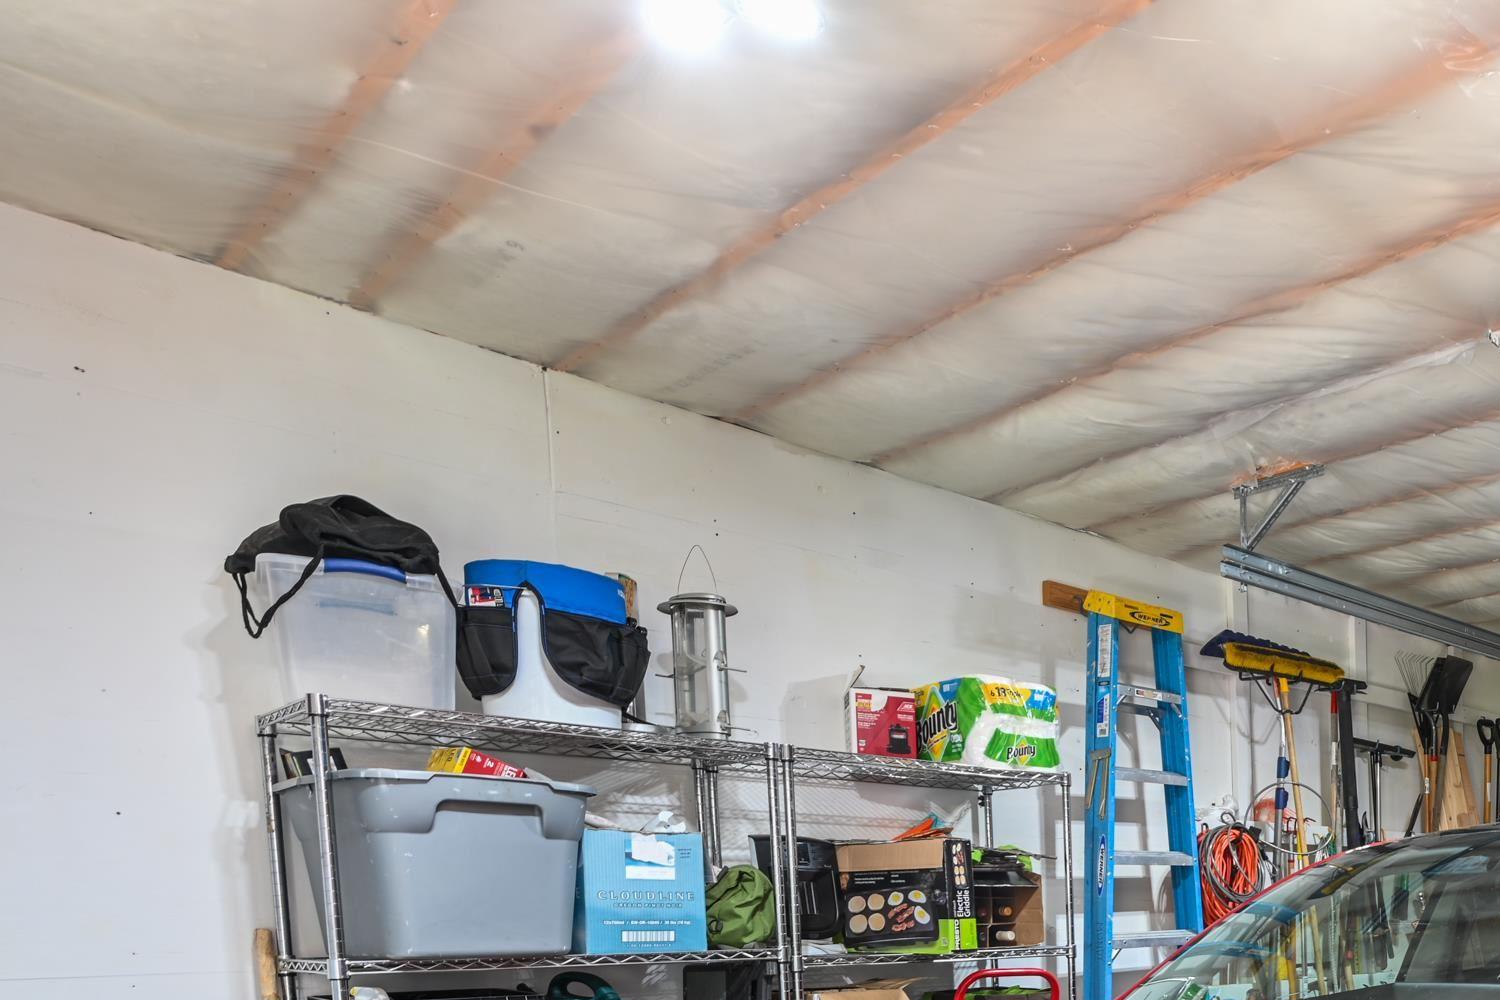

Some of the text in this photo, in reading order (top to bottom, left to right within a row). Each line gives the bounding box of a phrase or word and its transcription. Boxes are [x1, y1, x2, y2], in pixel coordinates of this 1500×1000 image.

[1006, 745, 1036, 760] Bounty
[598, 890, 696, 901] CLOUDLINE
[956, 889, 964, 917] Electric
[963, 889, 971, 917] Griddle
